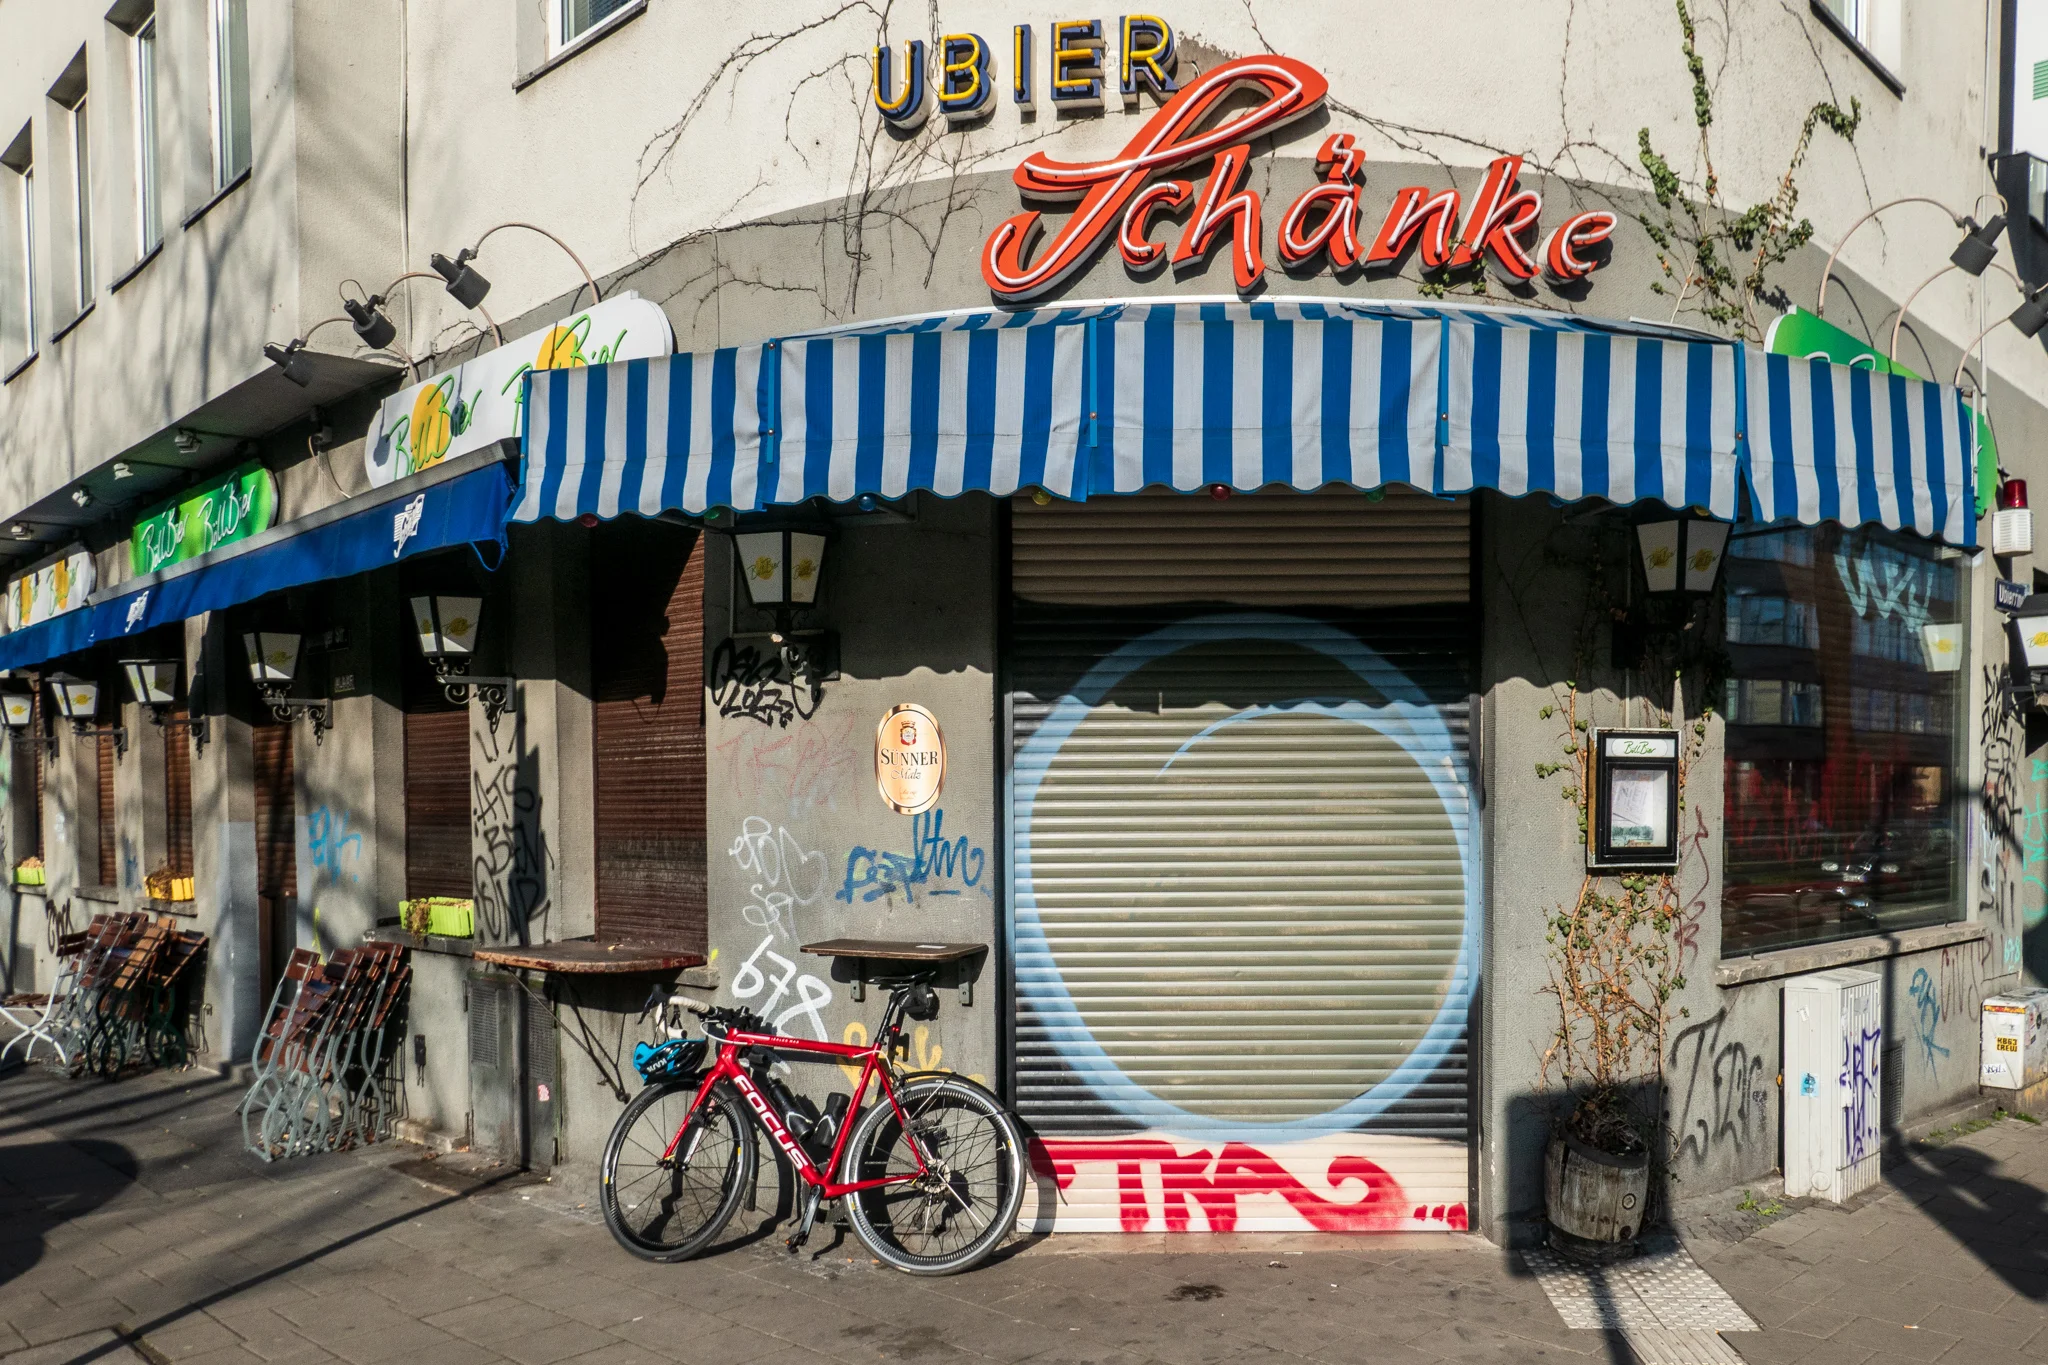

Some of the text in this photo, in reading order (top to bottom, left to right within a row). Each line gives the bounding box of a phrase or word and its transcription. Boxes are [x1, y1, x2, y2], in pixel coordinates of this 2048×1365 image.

[872, 14, 1178, 129] UBIER
[880, 748, 938, 766] SÜNNER
[890, 767, 921, 780] Malz
[733, 1074, 808, 1170] FOCUS
